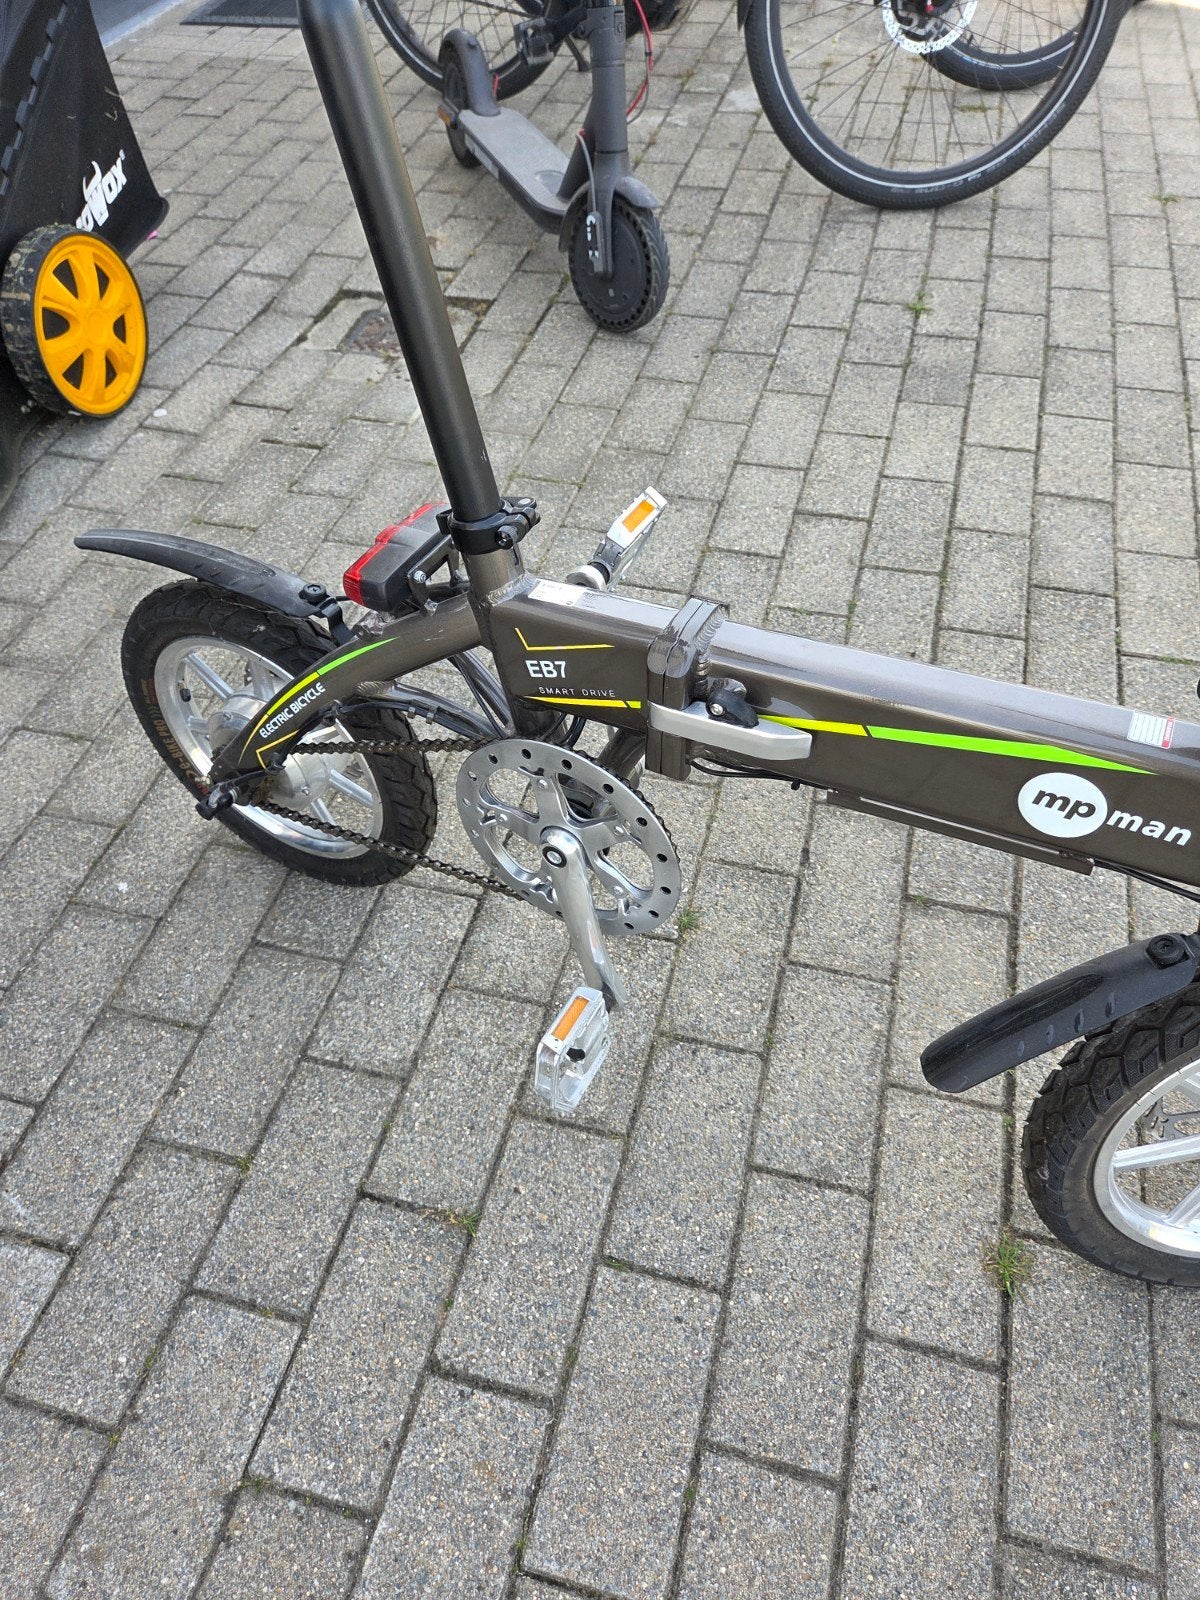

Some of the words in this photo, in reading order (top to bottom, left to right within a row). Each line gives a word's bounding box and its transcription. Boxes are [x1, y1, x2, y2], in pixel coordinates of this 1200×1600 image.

[525, 660, 566, 679] EB7
[539, 686, 575, 696] SMART
[582, 689, 616, 698] DRIVE
[259, 707, 294, 739] ELECTRIC
[289, 681, 326, 714] BICYCLE
